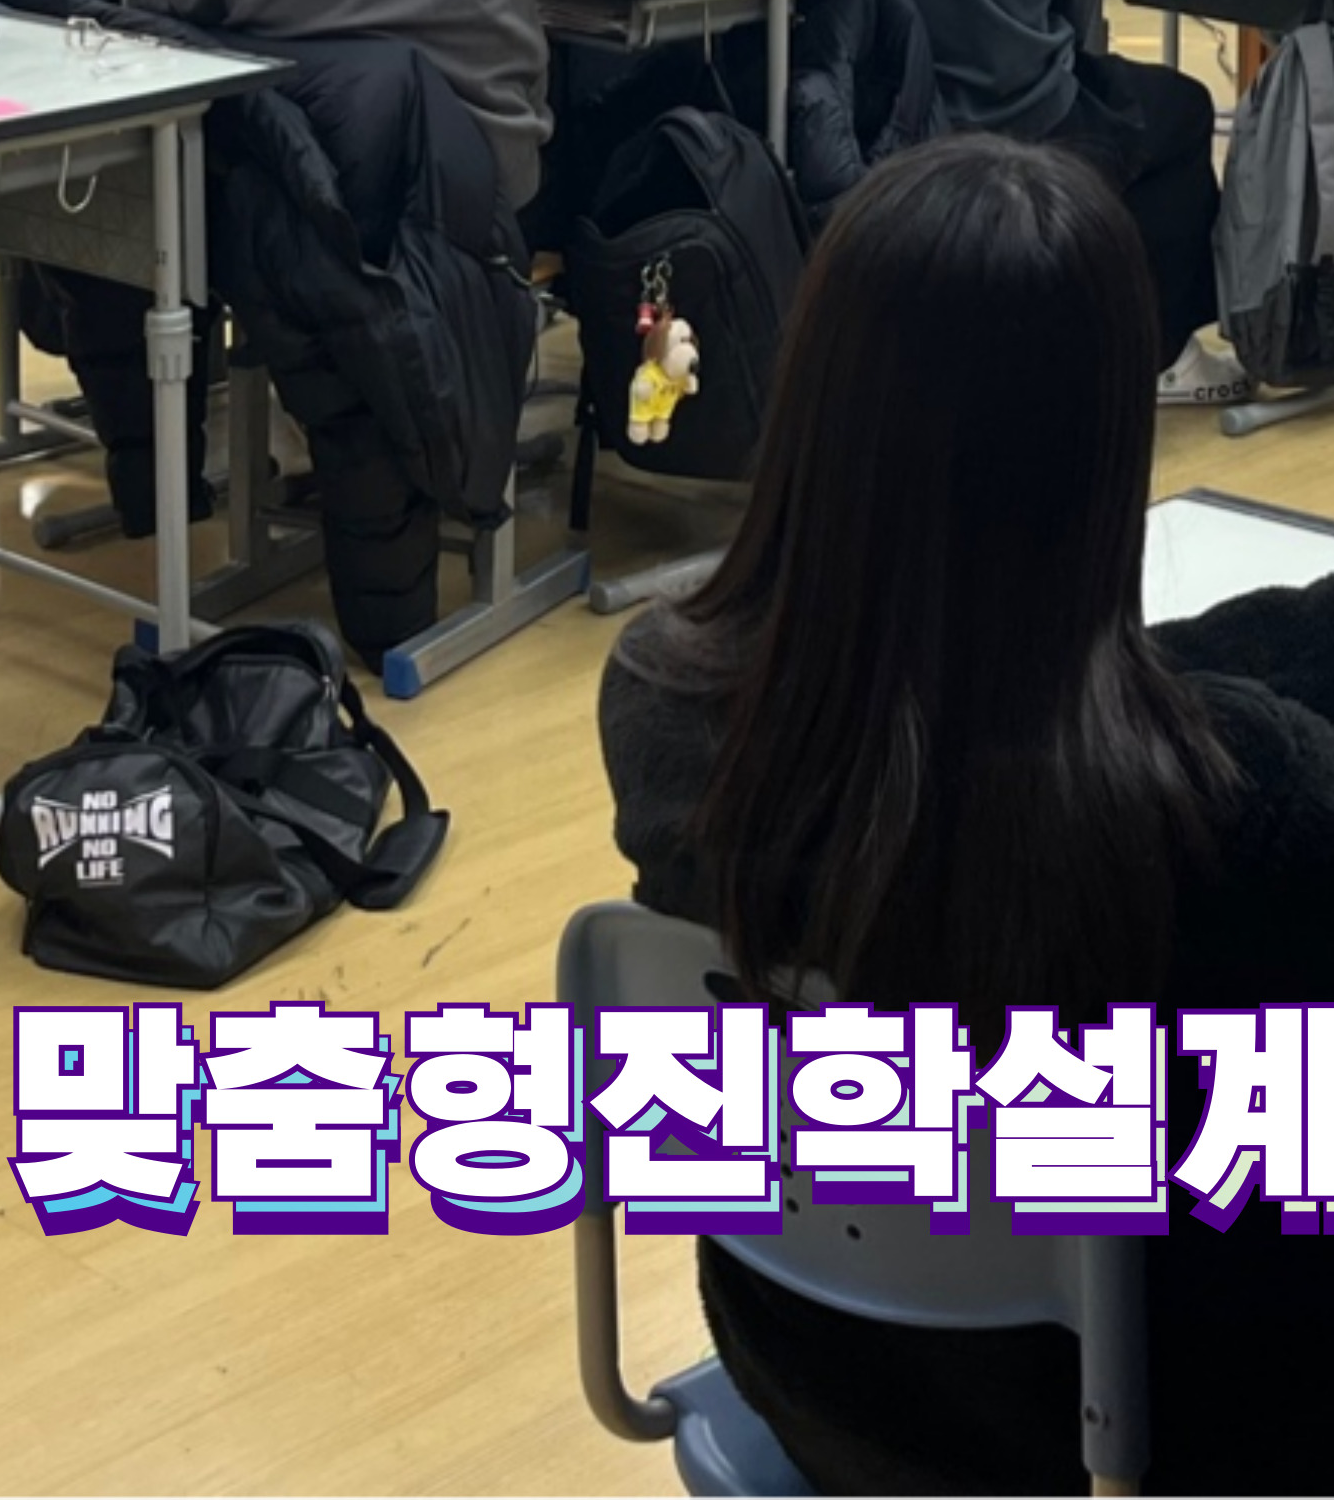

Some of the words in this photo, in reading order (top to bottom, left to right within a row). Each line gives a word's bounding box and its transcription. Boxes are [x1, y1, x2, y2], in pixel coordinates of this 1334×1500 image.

[1193, 381, 1252, 401] croc
[82, 789, 118, 811] NO
[82, 839, 118, 859] NO
[76, 857, 125, 881] LIFE
